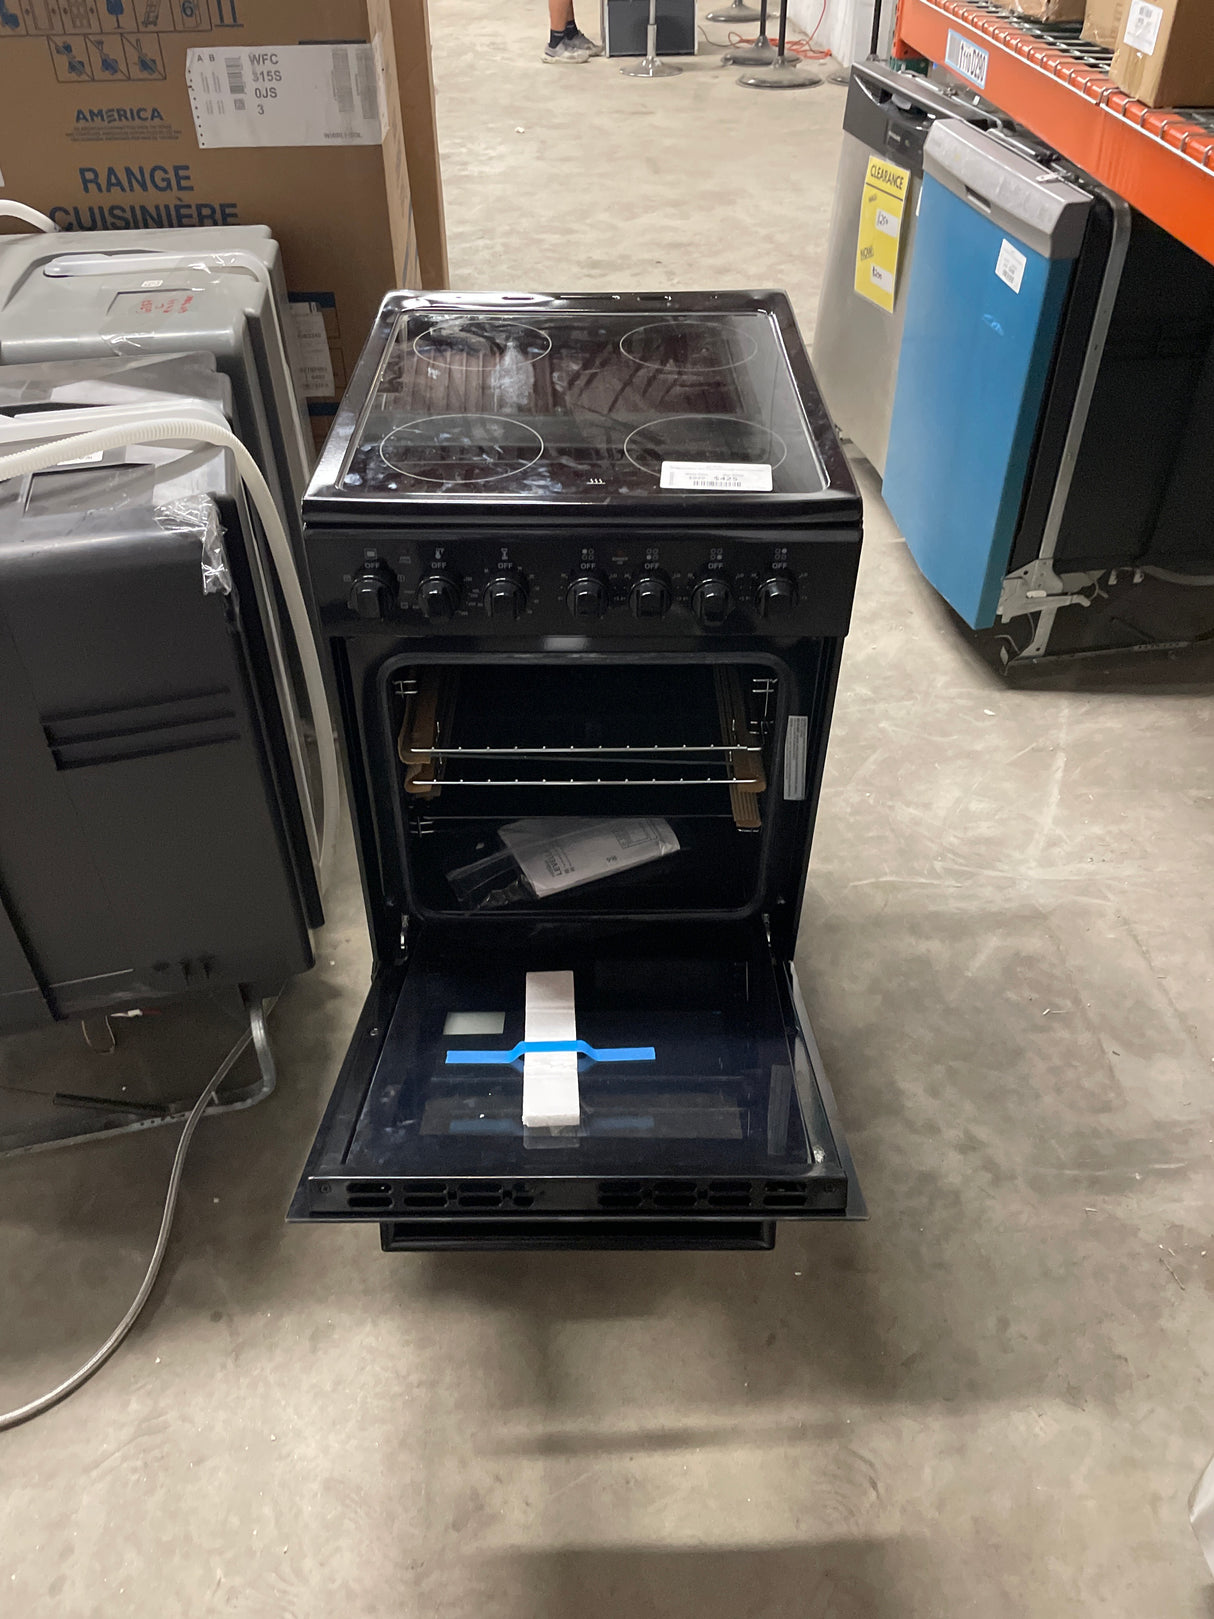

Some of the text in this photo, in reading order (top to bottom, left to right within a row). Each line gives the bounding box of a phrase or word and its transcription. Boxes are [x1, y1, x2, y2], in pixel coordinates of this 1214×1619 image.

[197, 54, 216, 62] A B
[249, 53, 280, 65] WFC
[252, 70, 282, 82] 315S
[257, 103, 265, 115] 3
[75, 107, 164, 124] AMERICA
[79, 165, 194, 193] RANGE
[870, 164, 905, 191] CLEARANCE
[49, 196, 240, 232] CUISINIÈRE
[364, 561, 380, 569] OFF
[431, 561, 447, 569] OFF
[580, 562, 596, 570] OFF
[644, 562, 660, 570] OFF
